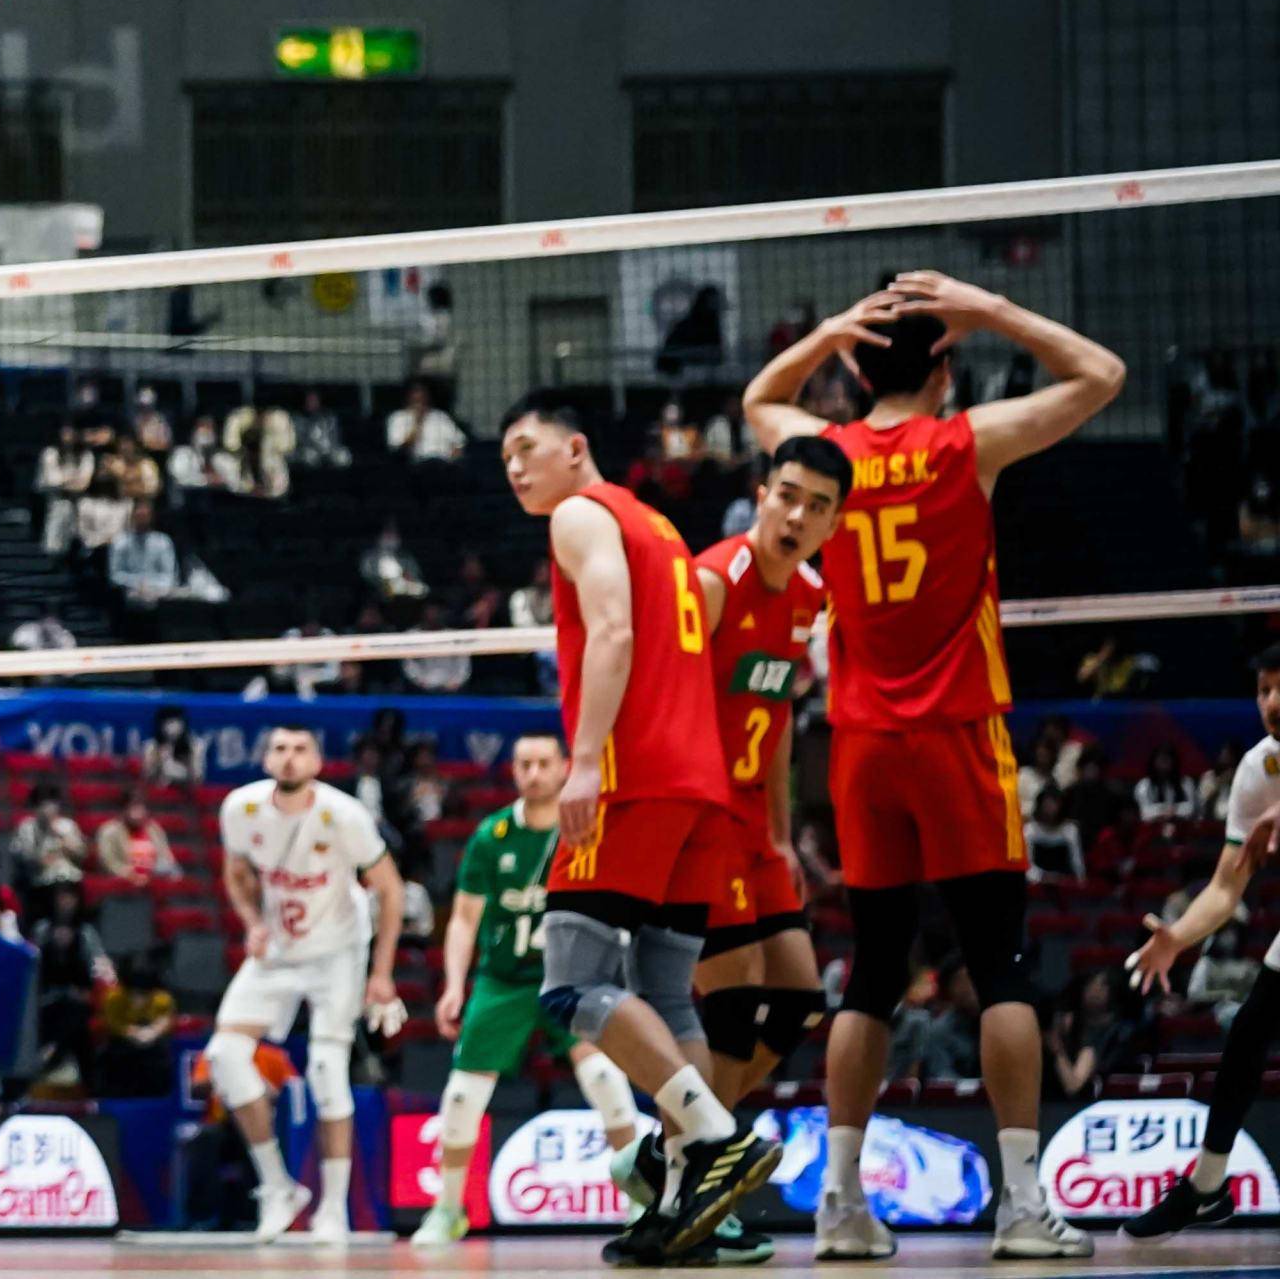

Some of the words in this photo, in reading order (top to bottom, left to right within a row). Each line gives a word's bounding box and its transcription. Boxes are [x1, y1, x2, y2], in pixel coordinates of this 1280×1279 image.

[845, 505, 928, 605] 15
[672, 557, 704, 654] 6
[733, 707, 771, 781] 3
[535, 1126, 608, 1162] 百岁
